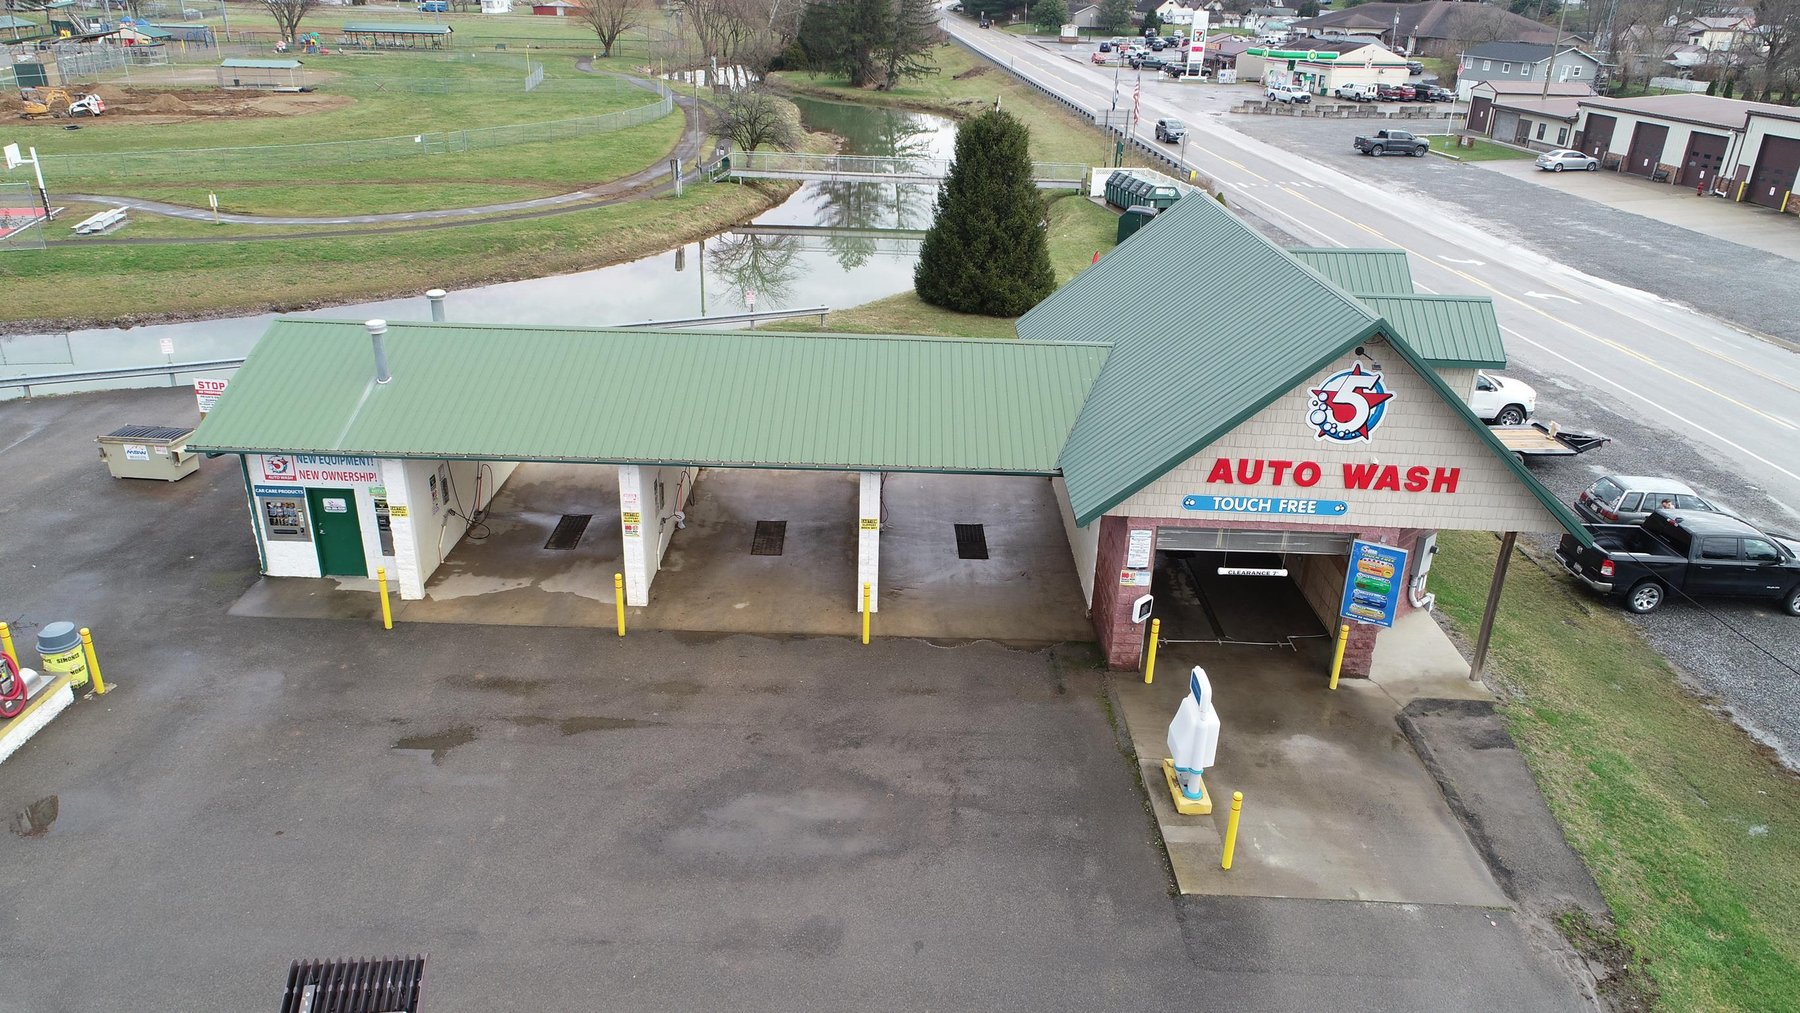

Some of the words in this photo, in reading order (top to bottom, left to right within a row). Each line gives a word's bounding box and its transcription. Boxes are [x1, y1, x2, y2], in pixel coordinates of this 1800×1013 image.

[198, 381, 225, 390] STOP
[1326, 374, 1381, 433] 5
[297, 455, 317, 464] NEW
[320, 456, 374, 466] EQUIPMENT!
[299, 469, 319, 480] NEW
[321, 470, 378, 482] OWNERSHIP!
[1206, 457, 1322, 488] AUTO
[1342, 463, 1461, 493] WASH
[1212, 496, 1272, 513] TOUCH
[1278, 498, 1317, 514] FREE
